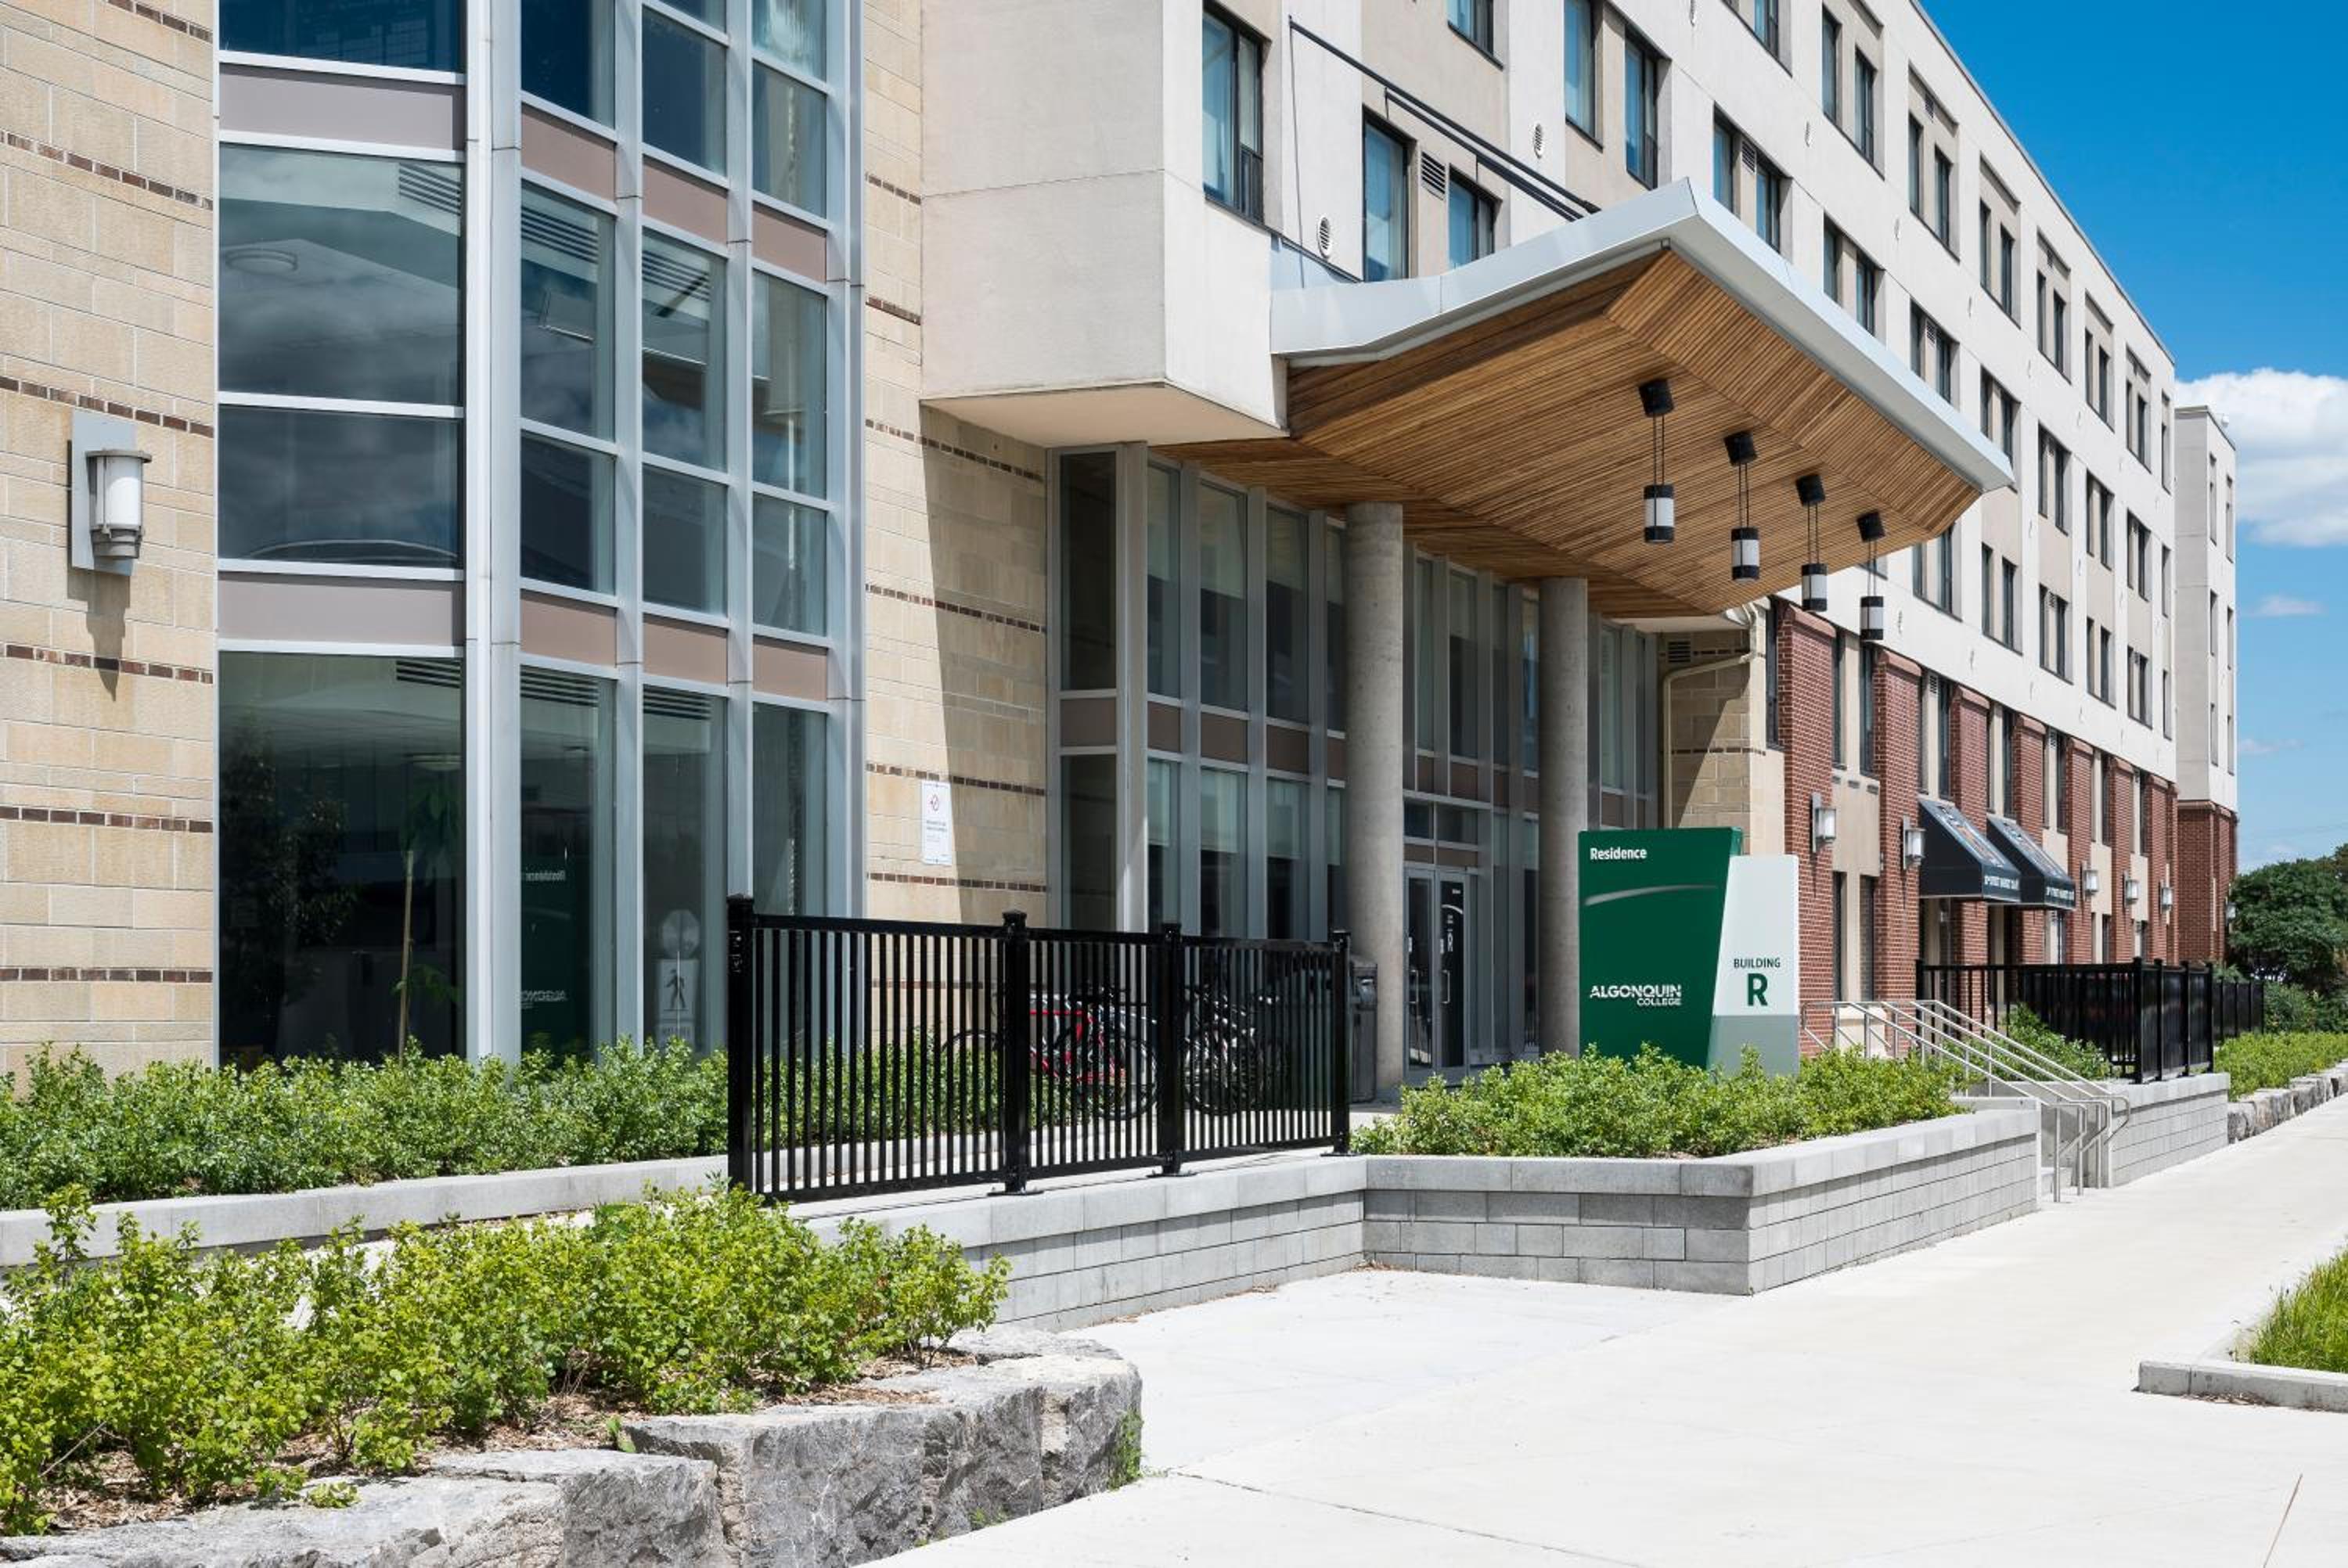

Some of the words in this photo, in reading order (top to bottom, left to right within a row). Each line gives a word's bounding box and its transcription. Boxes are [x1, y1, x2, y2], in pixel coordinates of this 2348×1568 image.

[1590, 847, 1648, 860] Residence
[1734, 958, 1781, 969] BUILDING
[1590, 984, 1682, 998] ALGONQUIN
[1747, 973, 1768, 1007] R
[1637, 998, 1681, 1006] COLLEGE
